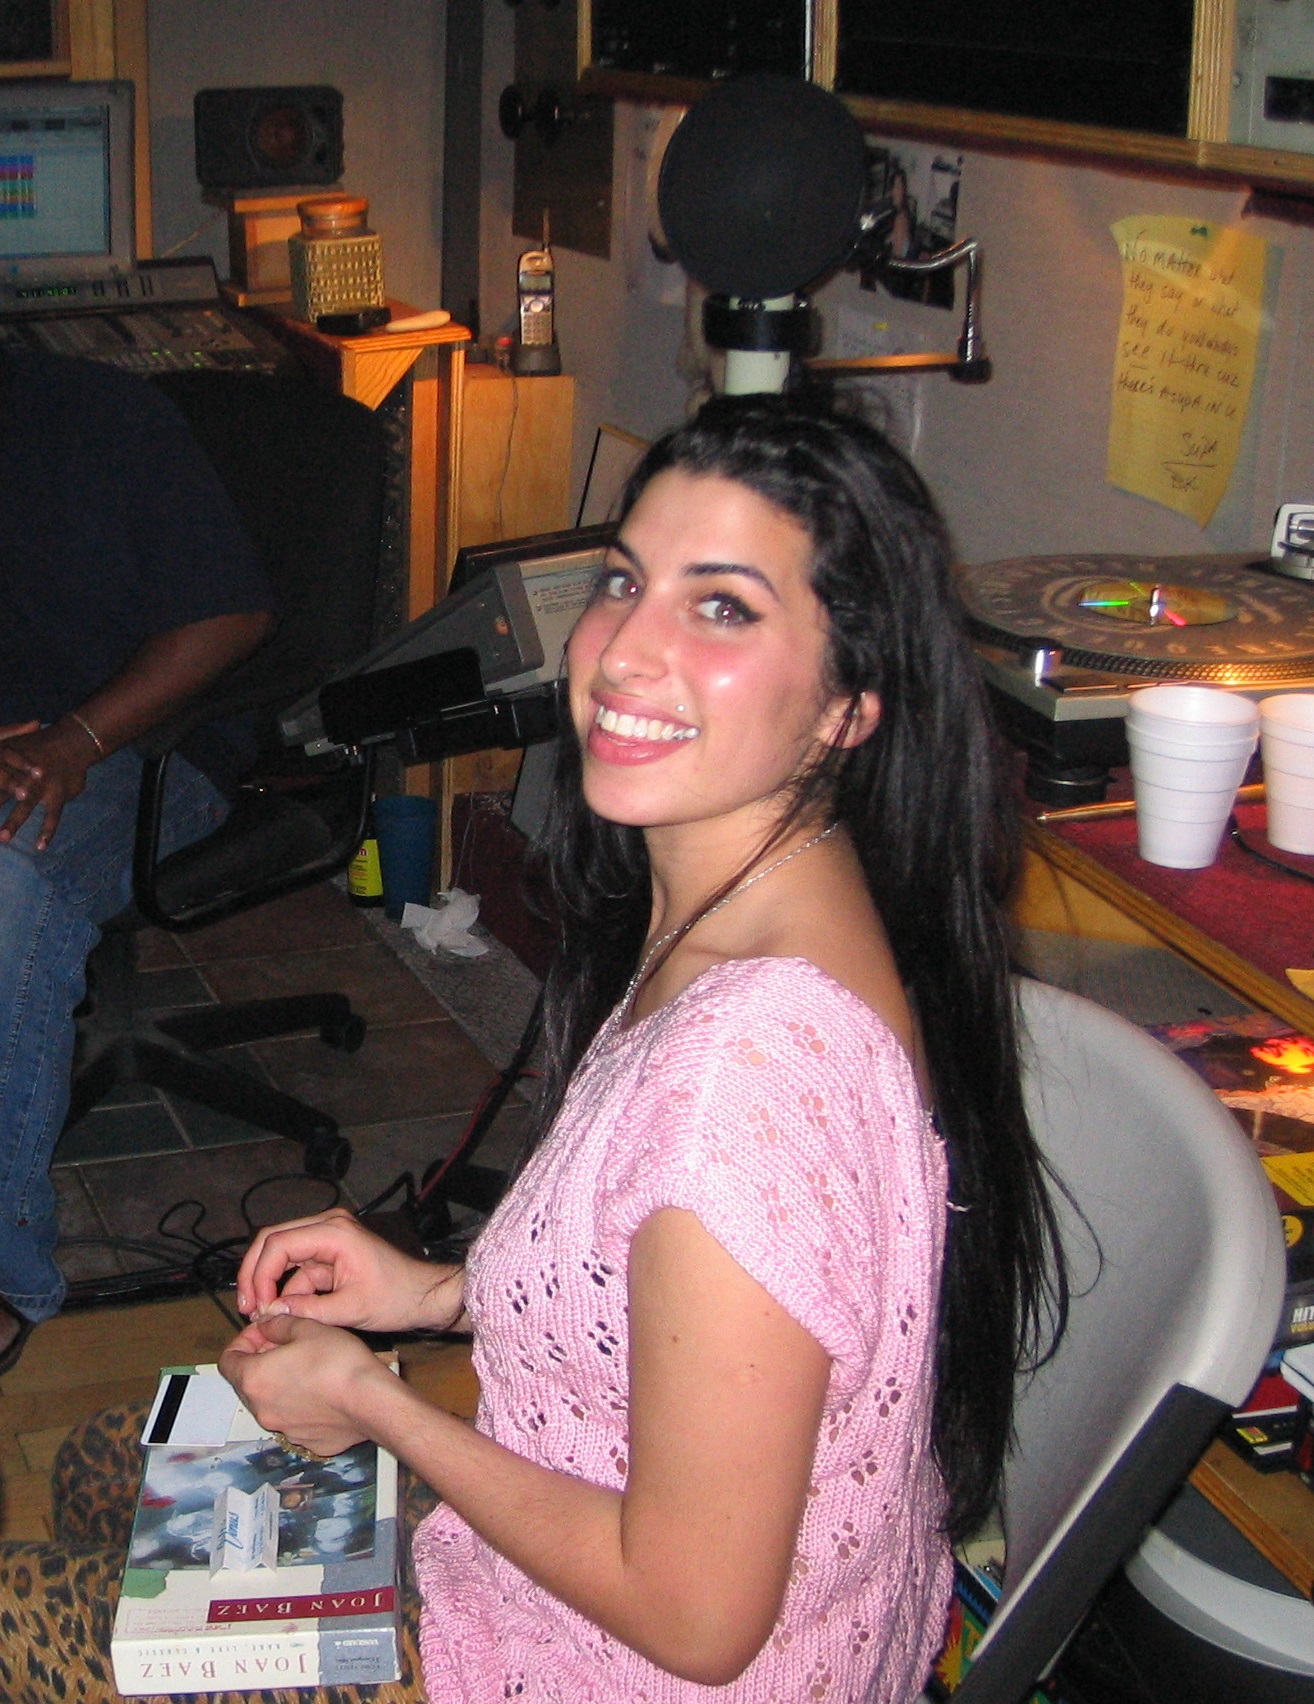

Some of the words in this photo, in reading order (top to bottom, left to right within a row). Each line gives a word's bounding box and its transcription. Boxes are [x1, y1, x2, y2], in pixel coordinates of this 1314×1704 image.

[217, 1601, 292, 1616] BAEZ
[311, 1592, 383, 1611] JOAN
[141, 1661, 216, 1679] BAEZ
[235, 1653, 307, 1674] JOAN
